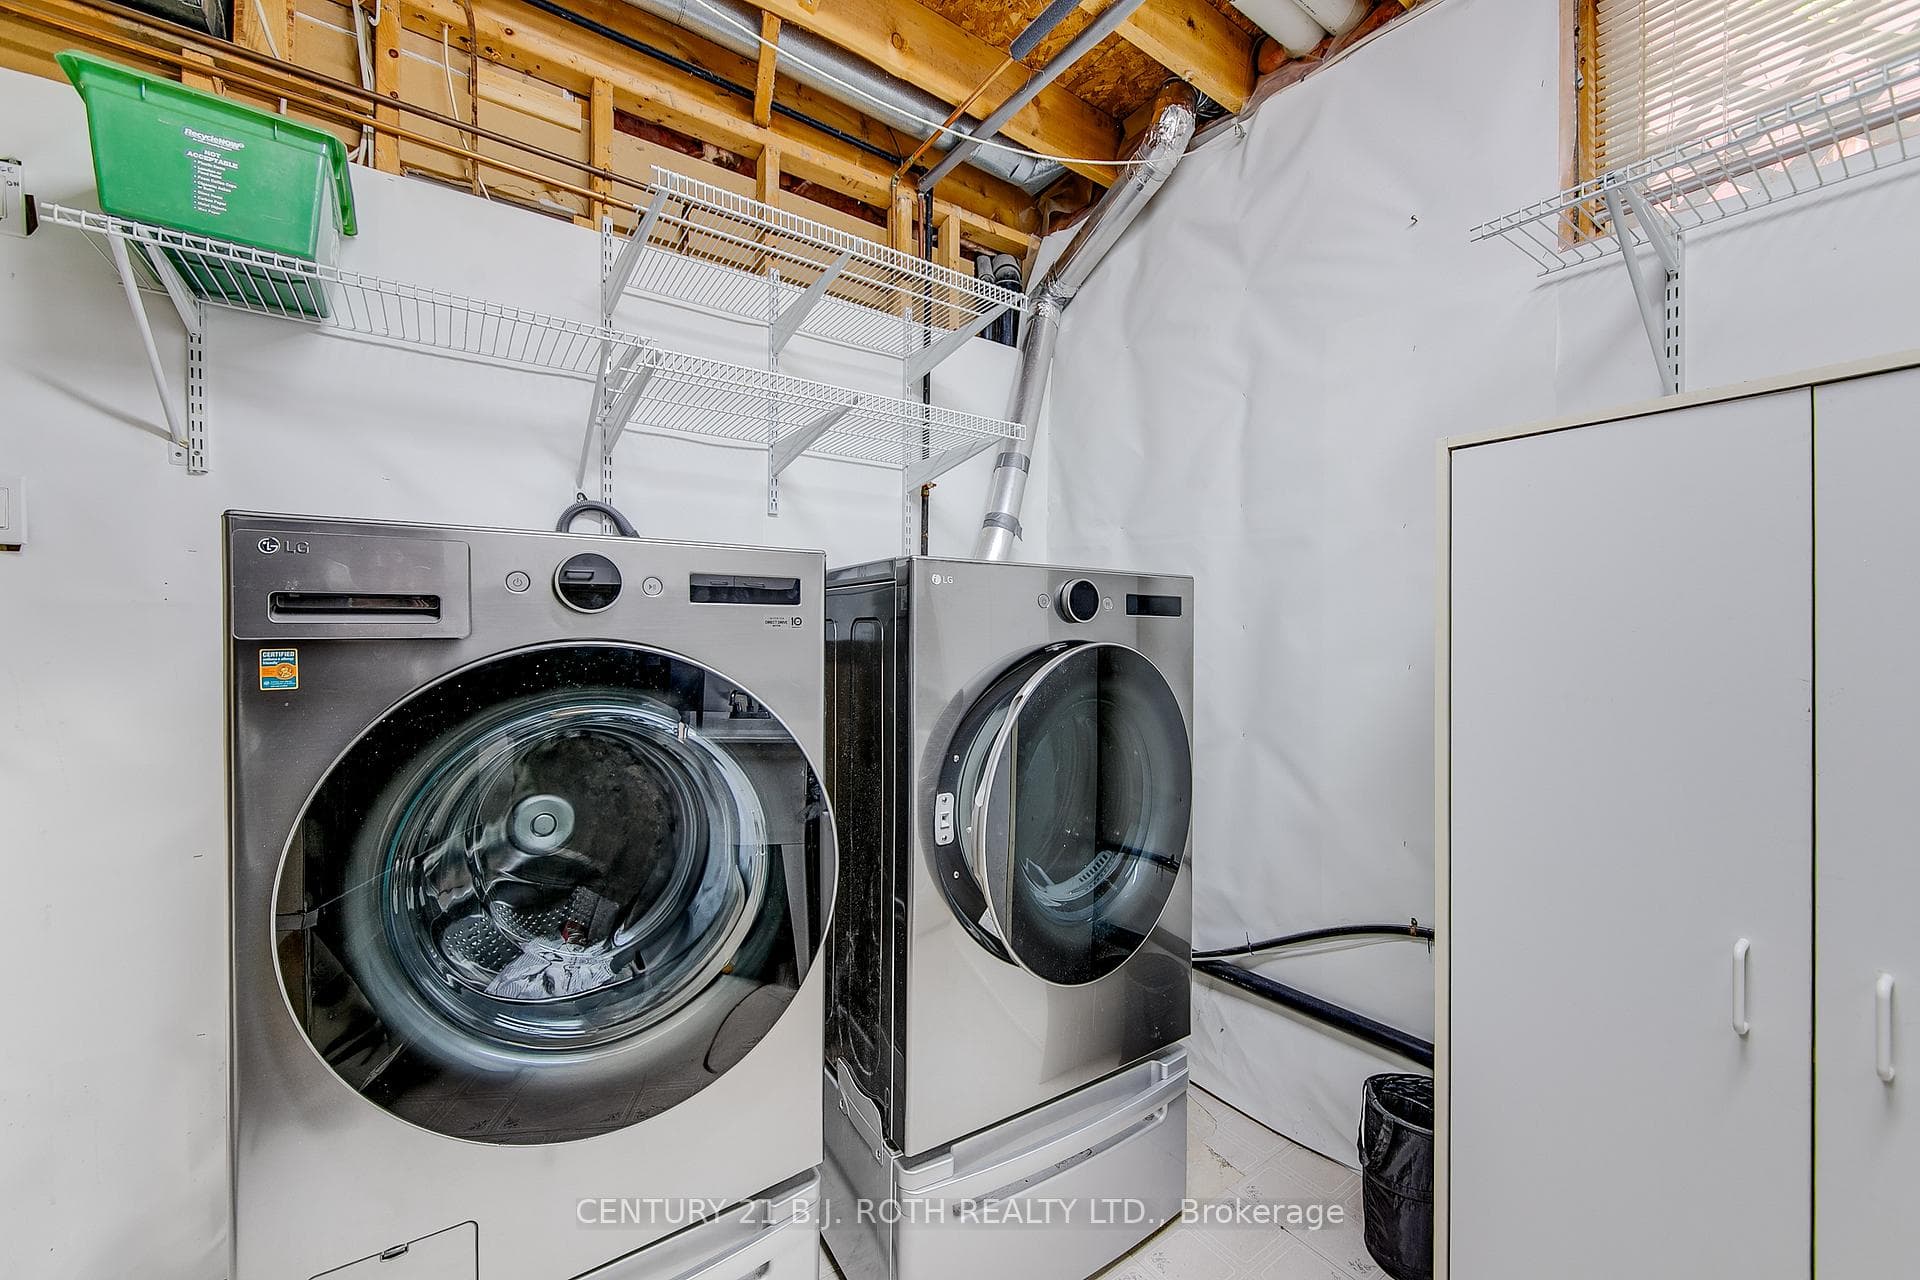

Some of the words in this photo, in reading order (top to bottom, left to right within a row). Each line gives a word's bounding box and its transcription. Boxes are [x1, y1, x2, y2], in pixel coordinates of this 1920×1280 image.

[203, 149, 221, 159] NOT
[187, 150, 239, 169] ACCEPTABLE
[284, 540, 310, 554] LG
[942, 575, 953, 584] LG
[791, 616, 803, 626] 10
